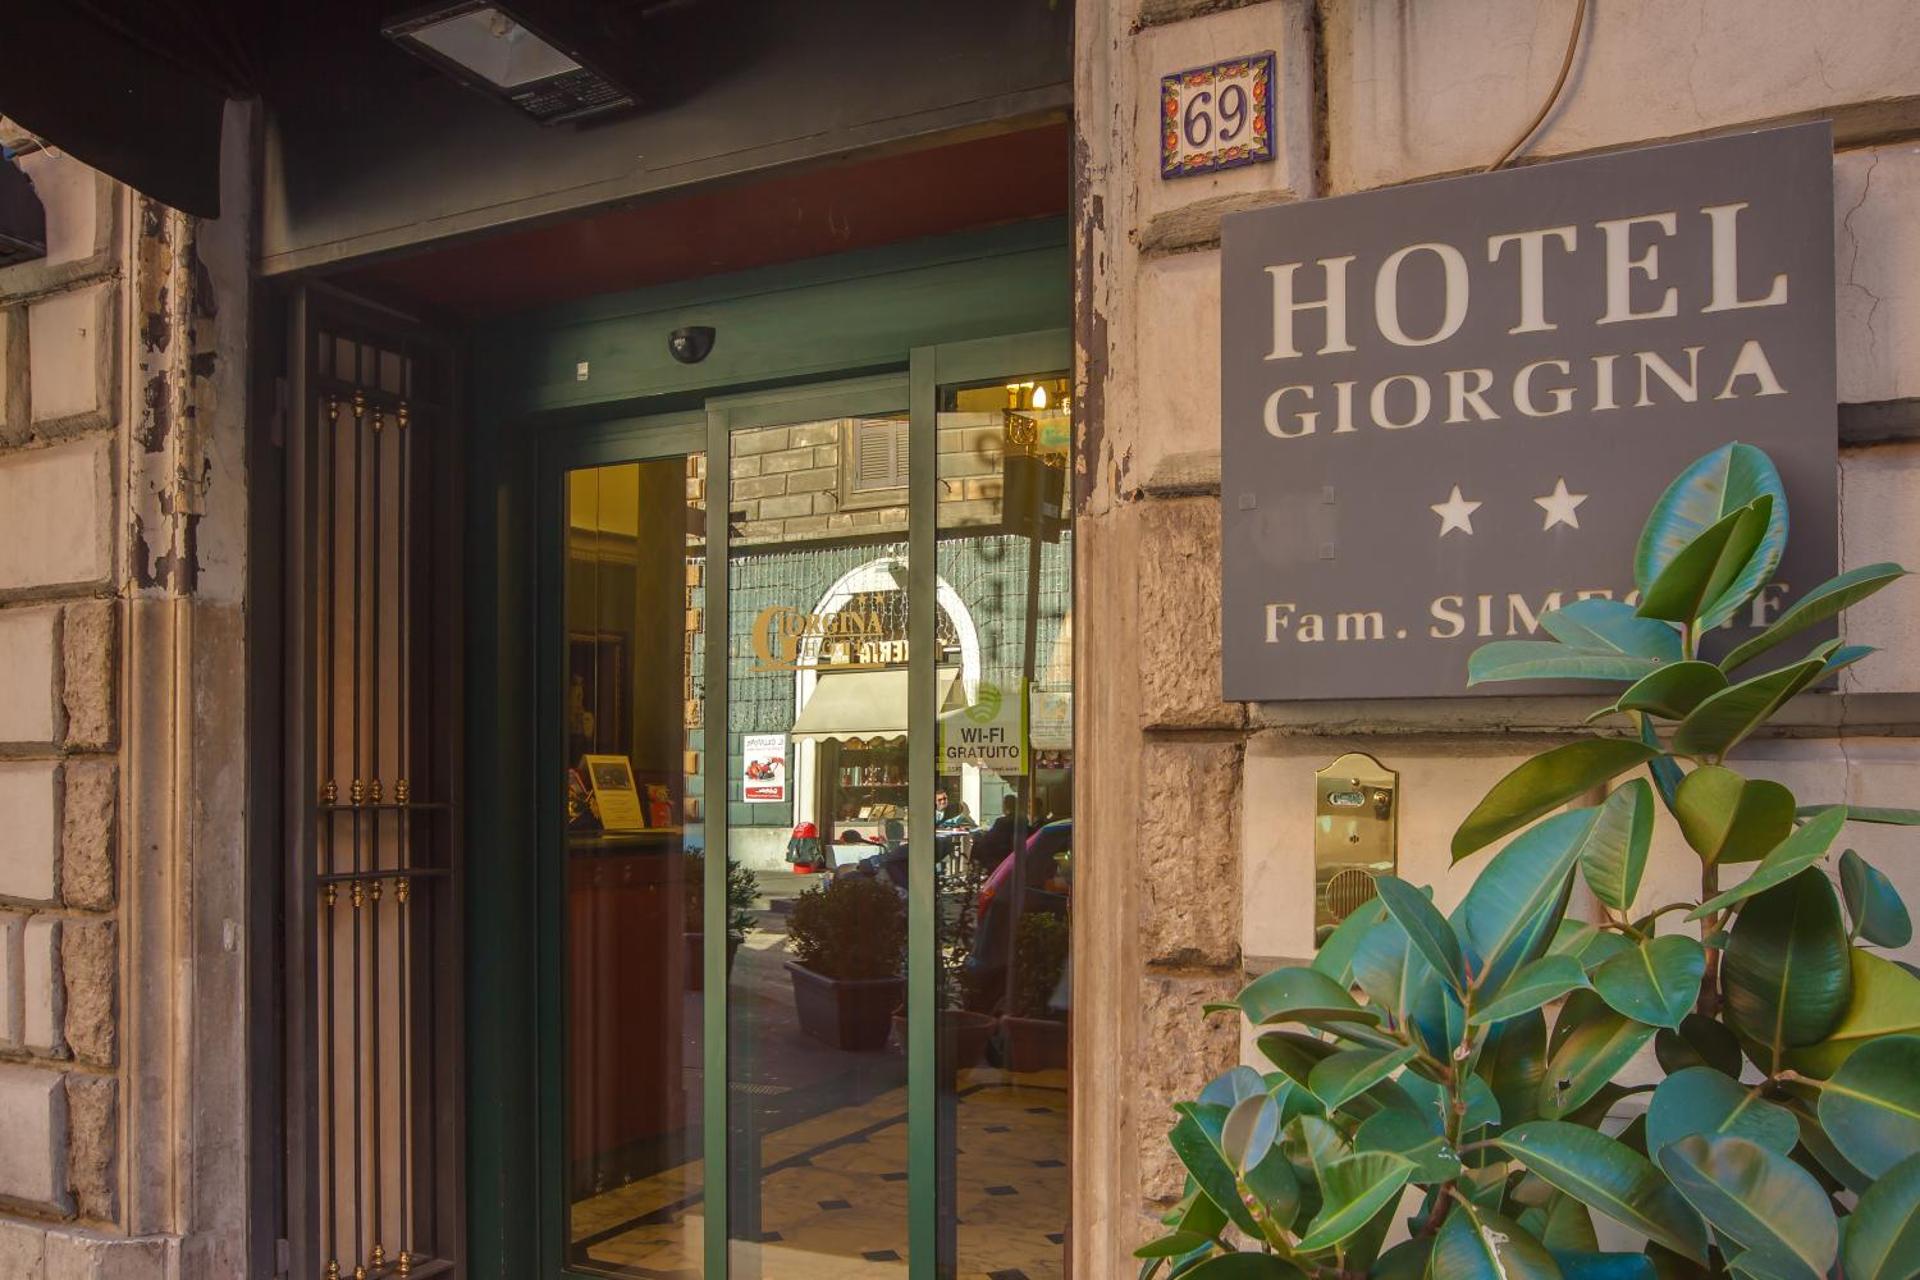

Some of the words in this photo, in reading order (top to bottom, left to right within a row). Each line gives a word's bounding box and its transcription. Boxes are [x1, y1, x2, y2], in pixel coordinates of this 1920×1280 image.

[1184, 84, 1248, 148] 69
[1263, 202, 1788, 361] HOTEL
[1263, 340, 1788, 438] GIORGINA
[752, 605, 883, 663] GIORGINA
[1264, 602, 1408, 643] Fam.
[946, 745, 1020, 759] GRATUITO
[960, 727, 1005, 743] WI-FI
